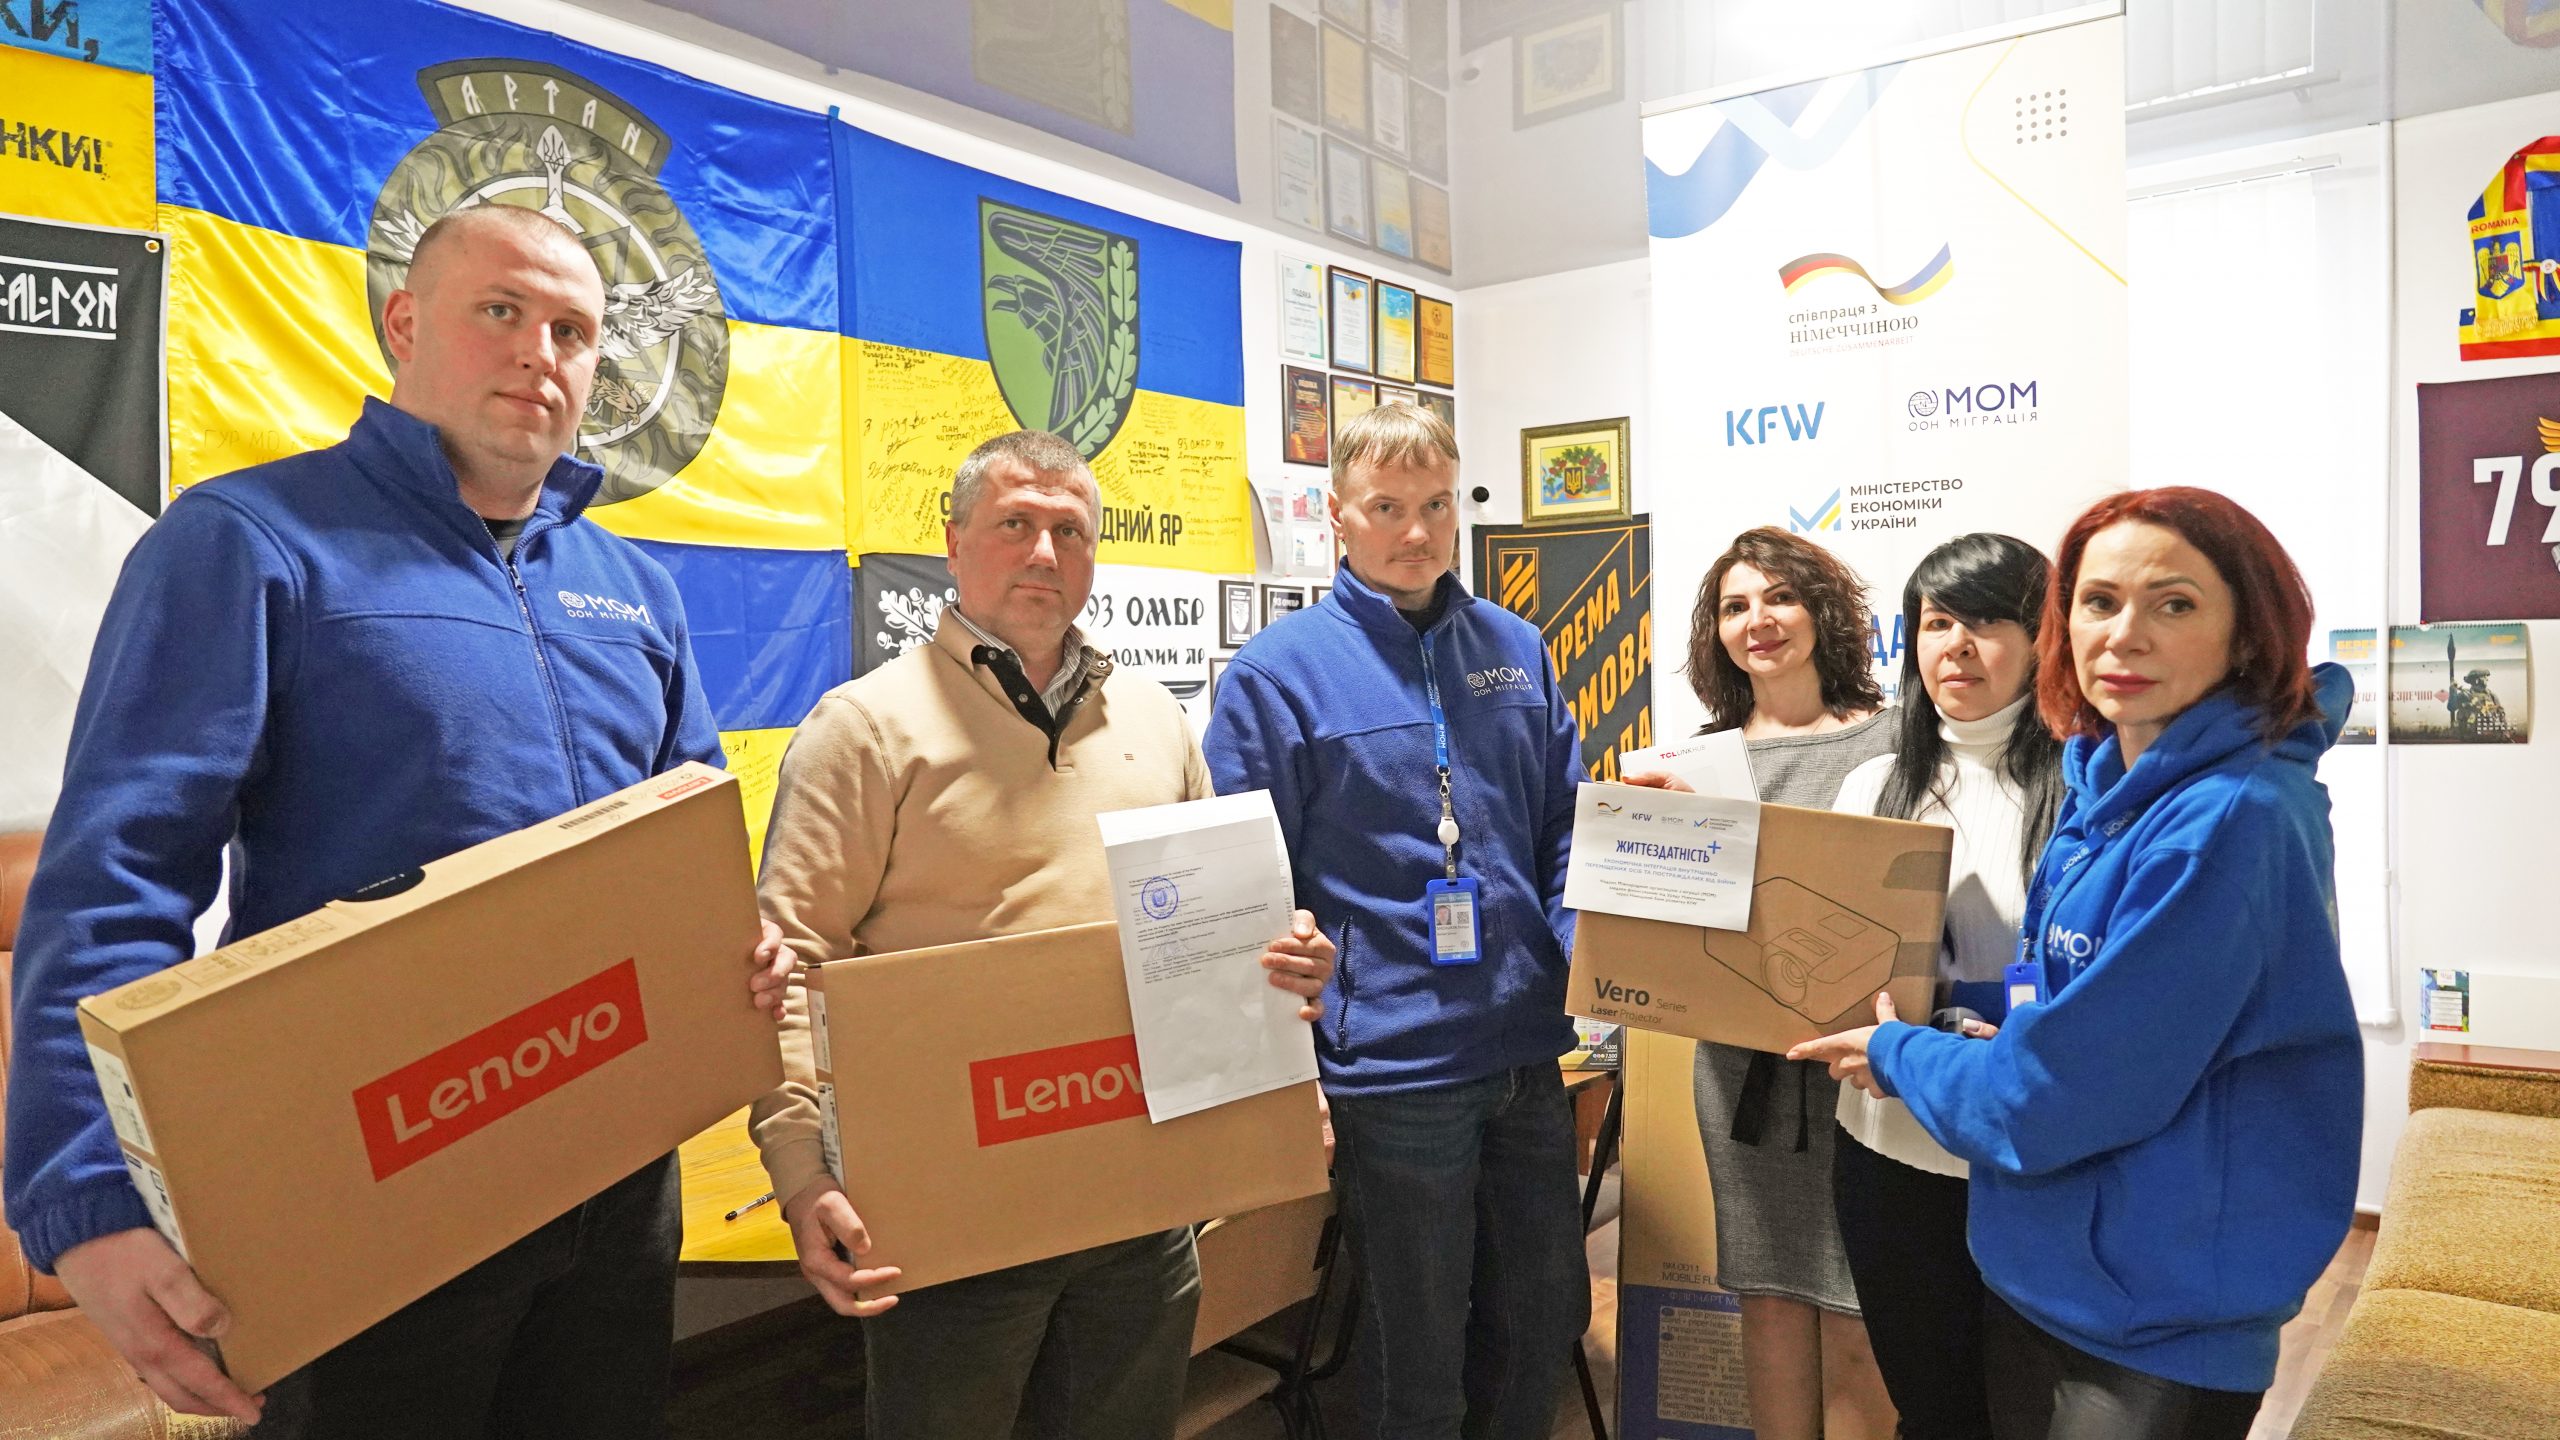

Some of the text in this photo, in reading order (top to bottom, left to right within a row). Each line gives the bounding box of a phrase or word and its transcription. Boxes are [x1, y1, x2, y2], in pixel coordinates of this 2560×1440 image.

[2471, 216, 2519, 234] ROMANIA
[1788, 304, 1878, 323] співпраця з
[1790, 315, 1919, 343] німеччиною
[1836, 336, 1914, 353] ZUSAMMENARBEIT
[1945, 381, 2037, 415] МОМ
[1726, 401, 1825, 447] KFW
[1908, 411, 2038, 432] ООН МІГРАЦІЯ
[1850, 478, 1963, 497] МІНІСТЕРСТВО
[1850, 498, 1943, 514] ЕКОНОМІКИ
[1100, 505, 1154, 544] ДНИЙ
[1160, 514, 1183, 546] ЯР
[1850, 514, 1917, 531] УКРАЇНИ
[567, 609, 594, 618] ООН
[584, 594, 651, 625] МОМ
[1087, 594, 1204, 628] 93 ОМБР
[1112, 648, 1205, 667] ЛОДНИЙ ЯР
[1484, 667, 1529, 684] МОМ
[1473, 683, 1533, 697] ООН МІГРАЦІЯ
[1632, 813, 1653, 822] KFW
[2062, 852, 2082, 873] МОМ
[1594, 977, 1687, 1013] Vero Series
[1591, 1004, 1663, 1024] Laser Projector
[386, 1001, 621, 1144] Lenovo
[993, 1063, 1143, 1121] Lenov
[1662, 1272, 1700, 1284] MOBILE
